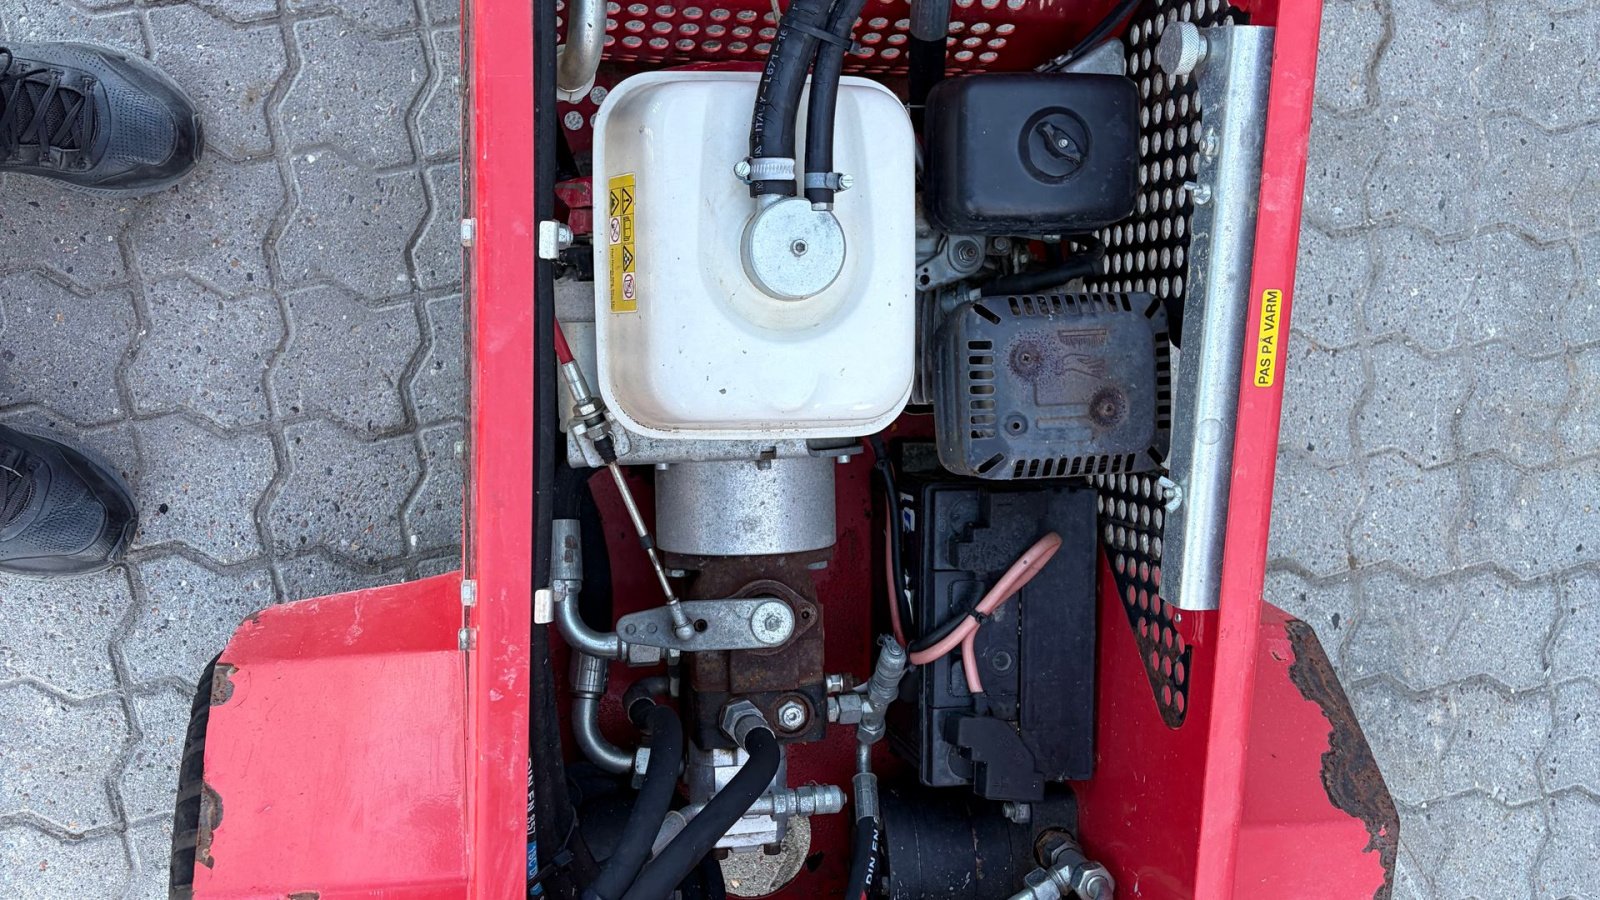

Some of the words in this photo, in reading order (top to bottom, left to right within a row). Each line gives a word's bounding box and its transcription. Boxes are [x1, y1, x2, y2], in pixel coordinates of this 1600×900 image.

[755, 96, 767, 132] ITALY
[1264, 291, 1278, 331] VARM
[1260, 336, 1274, 354] PÅ
[1258, 358, 1271, 385] PAS
[866, 856, 876, 885] DIN
[872, 829, 879, 852] EN
